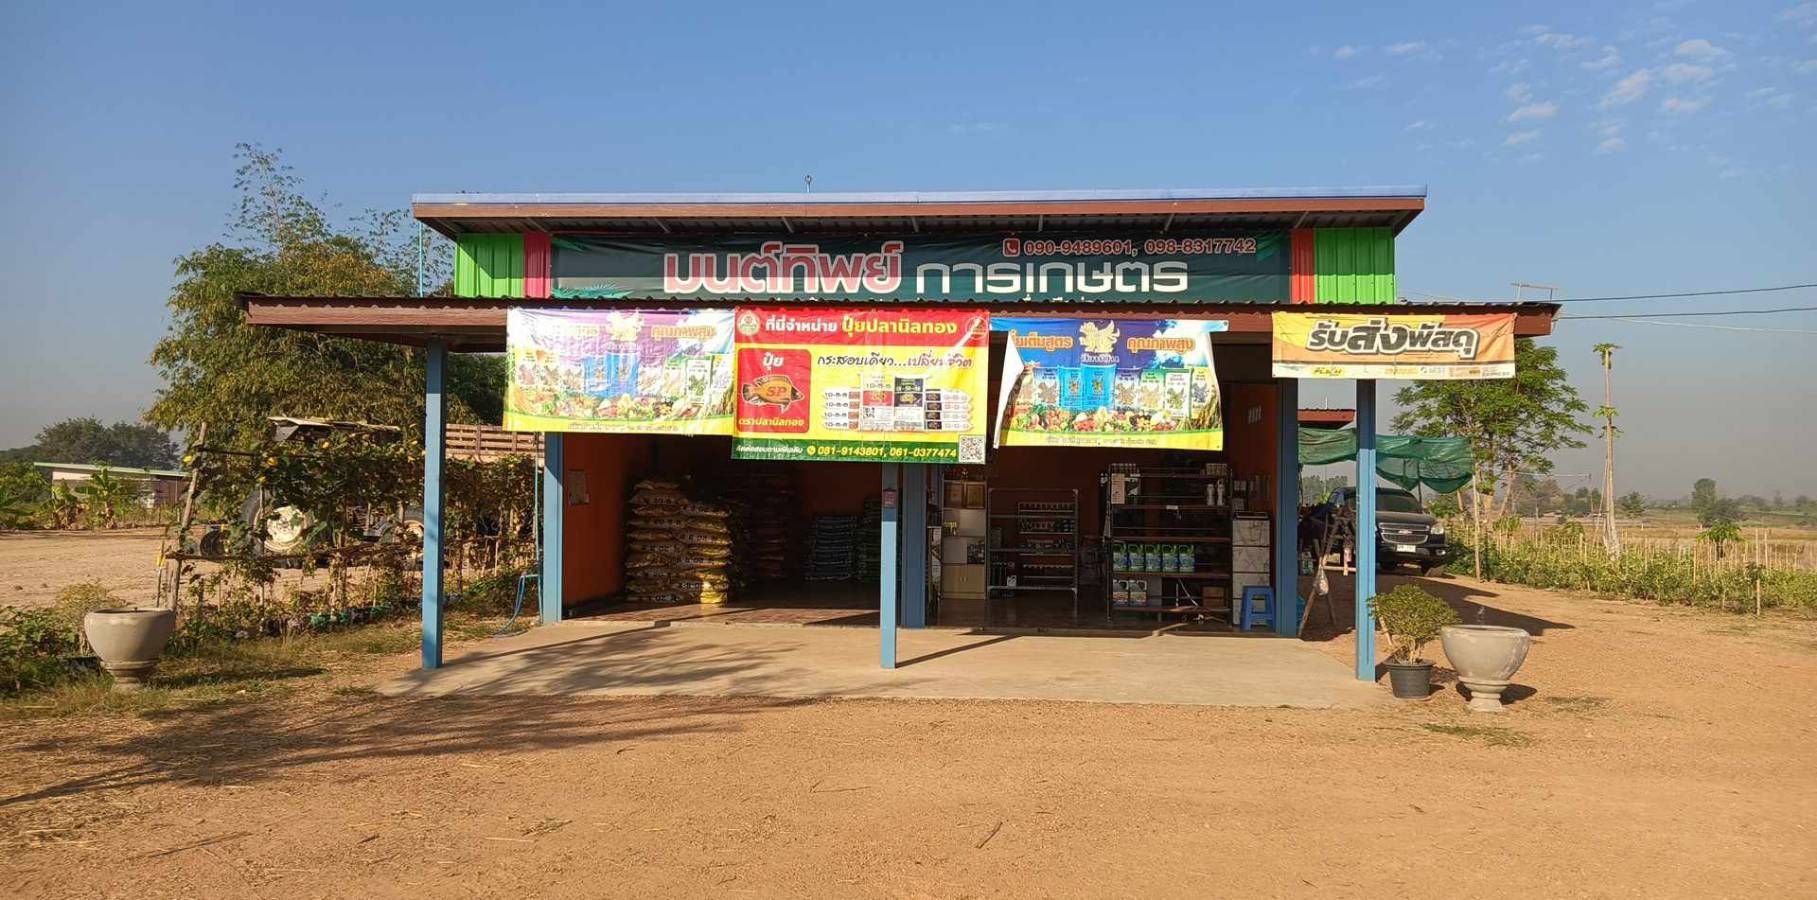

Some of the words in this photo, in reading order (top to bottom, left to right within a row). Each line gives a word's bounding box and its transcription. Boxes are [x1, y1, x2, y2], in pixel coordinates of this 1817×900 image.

[1023, 239, 1138, 257] 090-9489601,
[1144, 238, 1256, 255] 098-8317742
[664, 240, 904, 294] มนต์ทิพย์
[916, 261, 1189, 294] การเกษตร
[764, 314, 838, 334] ที่นี่จำหน่าย
[841, 315, 958, 338] ปุ๋ยปลานิลทอง
[1126, 336, 1197, 354] คุณภาพสูง
[1307, 318, 1479, 359] รับส่งพัสดุ
[762, 351, 784, 371] ปุ๋ย
[818, 446, 887, 458] 081-9143801,
[890, 447, 957, 458] 061-0377474
